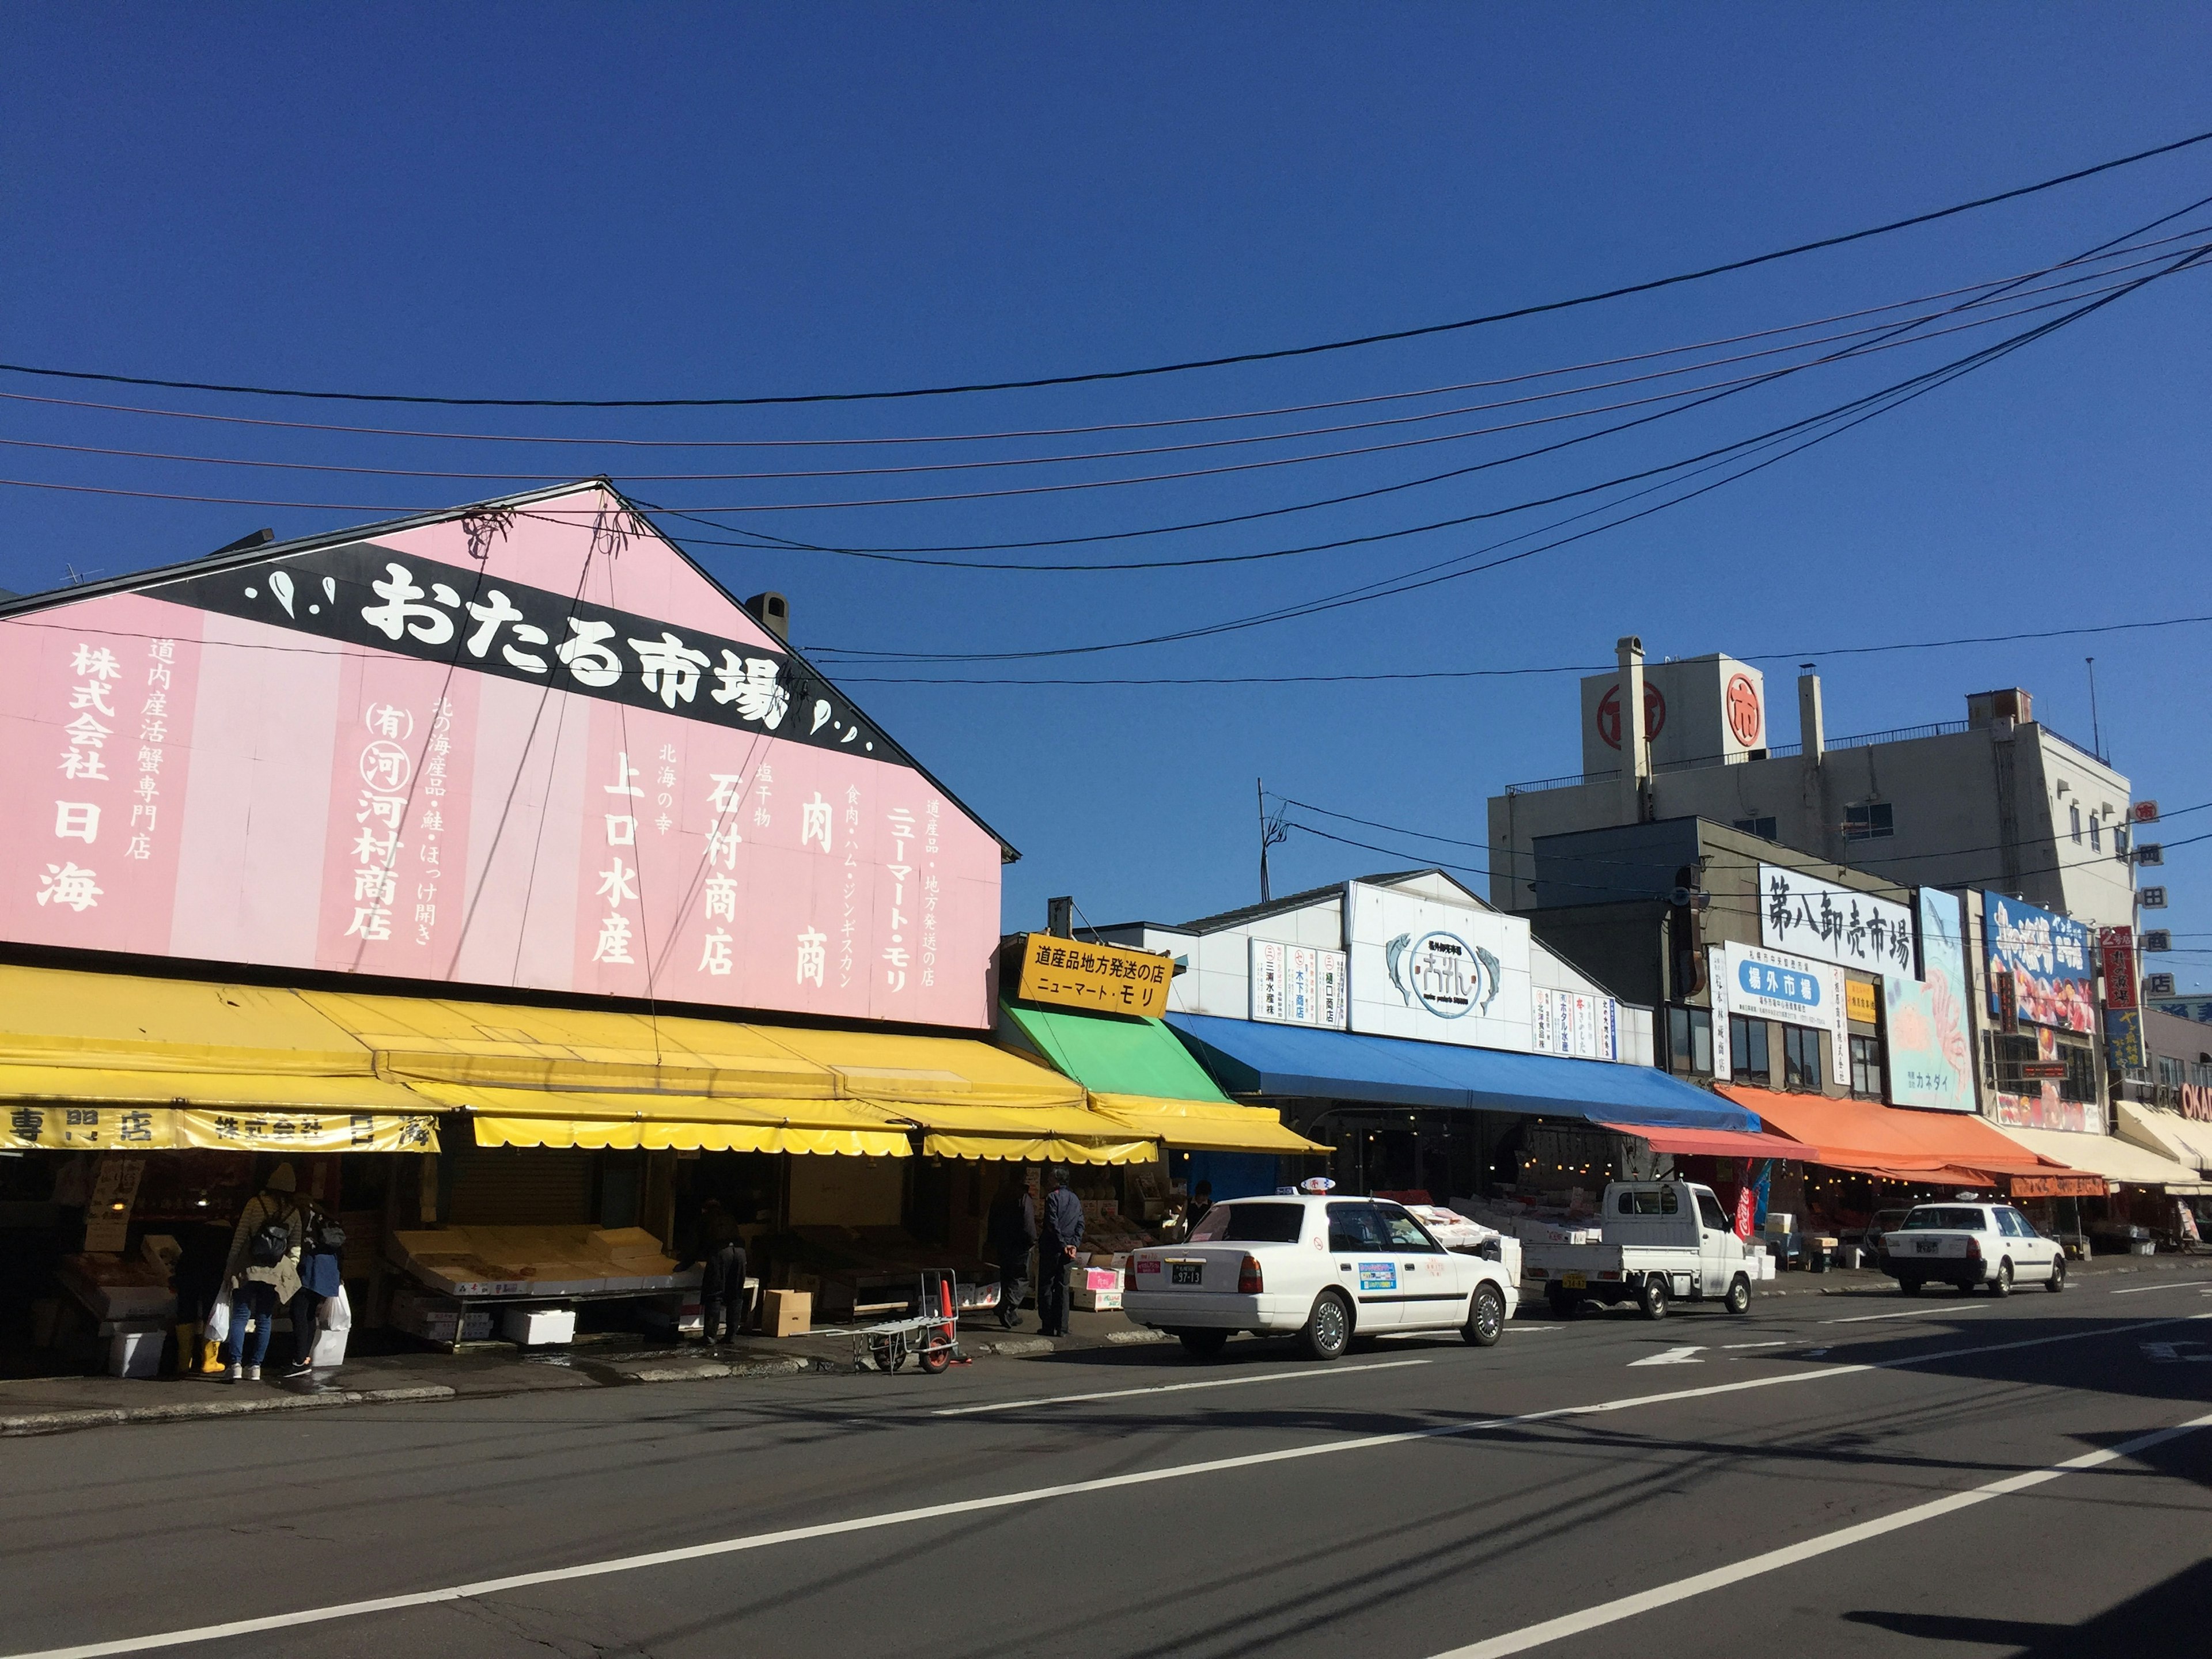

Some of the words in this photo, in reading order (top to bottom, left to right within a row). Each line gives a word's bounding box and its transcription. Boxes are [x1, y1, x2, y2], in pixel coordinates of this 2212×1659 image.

[361, 563, 791, 731] おたる市場
[124, 638, 175, 860] 道内産活蟹専門店
[654, 744, 677, 836] 北海の幸
[414, 698, 453, 946] 北の海産品・鮭・ほっけ開き
[592, 752, 645, 965] 上口水産
[698, 773, 744, 976] 石村商店
[839, 783, 862, 989] 食肉・ハム・ジンギスカン
[881, 807, 916, 993] ニューマート・モリ
[921, 800, 940, 988] 道産品・地方発送の店
[1035, 945, 1165, 984] 道産品地方発送の店
[1770, 875, 1911, 974] 第八卸売市場
[1037, 977, 1153, 1007] ニューマート・モリ
[1296, 970, 1304, 1019] 木下商店
[1749, 966, 1813, 1000] 場外市場
[9, 1108, 153, 1142] 専門店
[1916, 1071, 1948, 1092] カネダイ
[1178, 1272, 1200, 1283] 97-13
